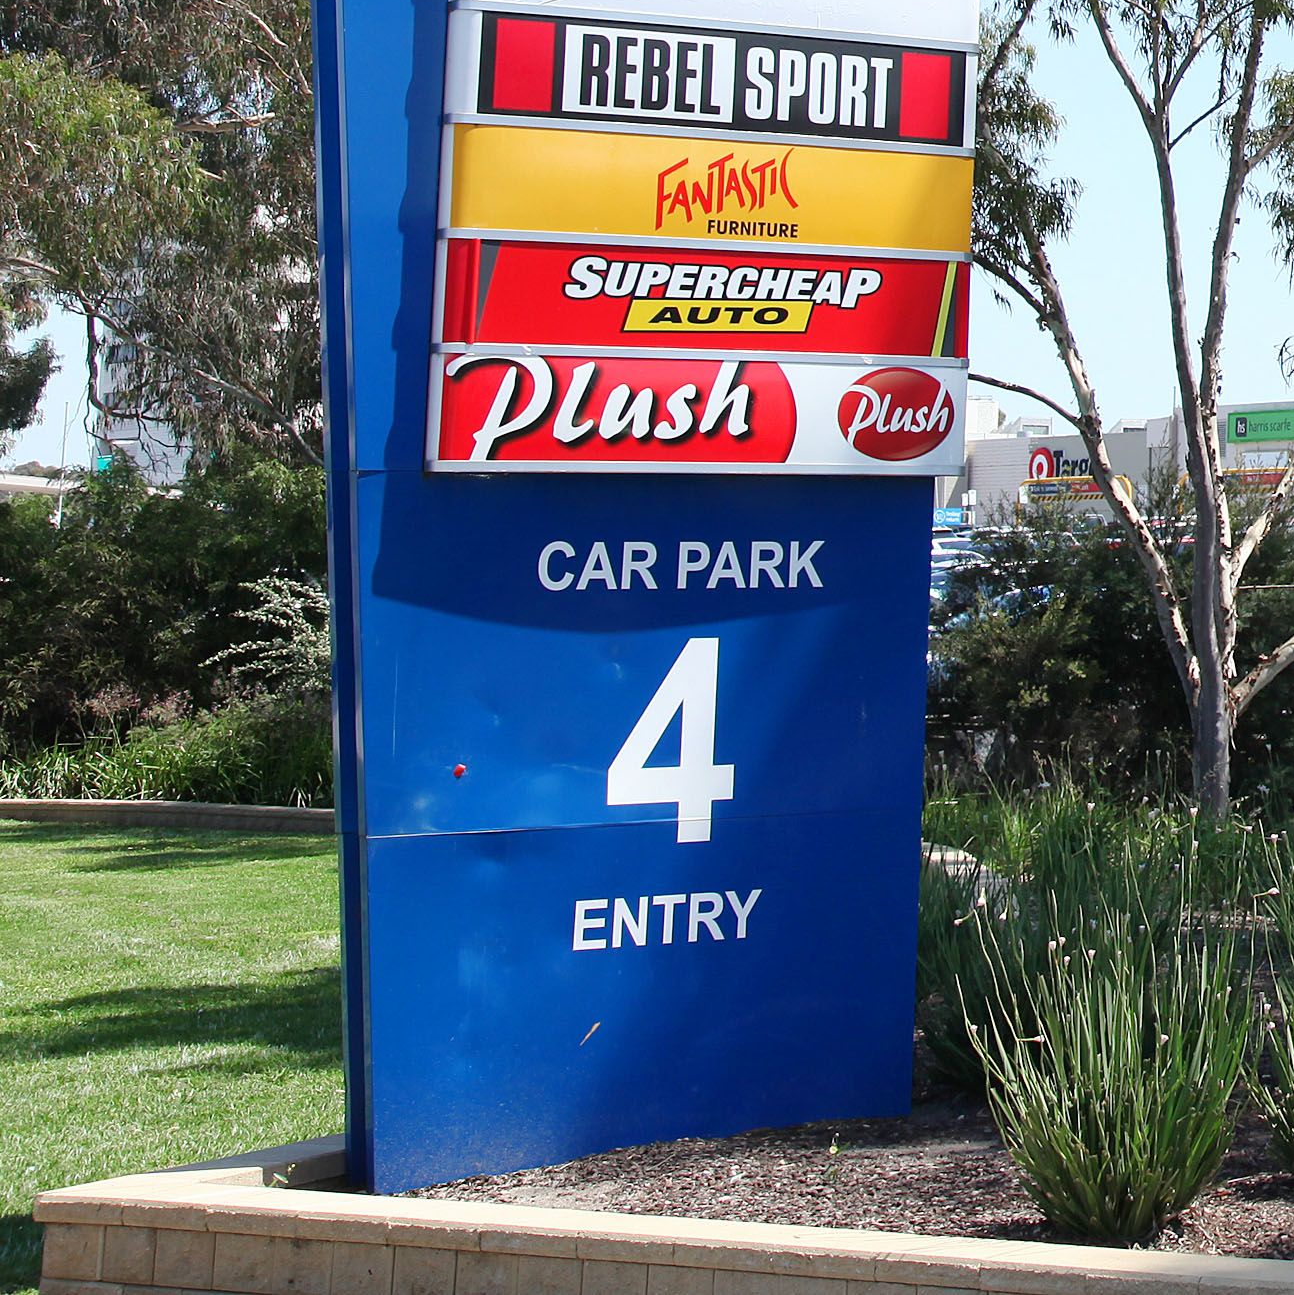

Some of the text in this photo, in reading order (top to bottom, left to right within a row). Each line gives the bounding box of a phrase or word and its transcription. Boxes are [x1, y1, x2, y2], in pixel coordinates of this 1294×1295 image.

[579, 33, 894, 130] REBEL SPORT
[706, 218, 799, 239] FURNITURE
[563, 255, 882, 310] SUPERCHEAP
[647, 305, 790, 326] AUTO
[444, 353, 750, 461] Plush
[847, 370, 950, 445] Plush
[1249, 420, 1269, 433] harris
[1269, 418, 1292, 433] scarfe
[1053, 449, 1091, 479] Targ
[537, 539, 826, 592] CAR PARK
[605, 636, 735, 843] 4
[571, 888, 763, 952] ENTRY
